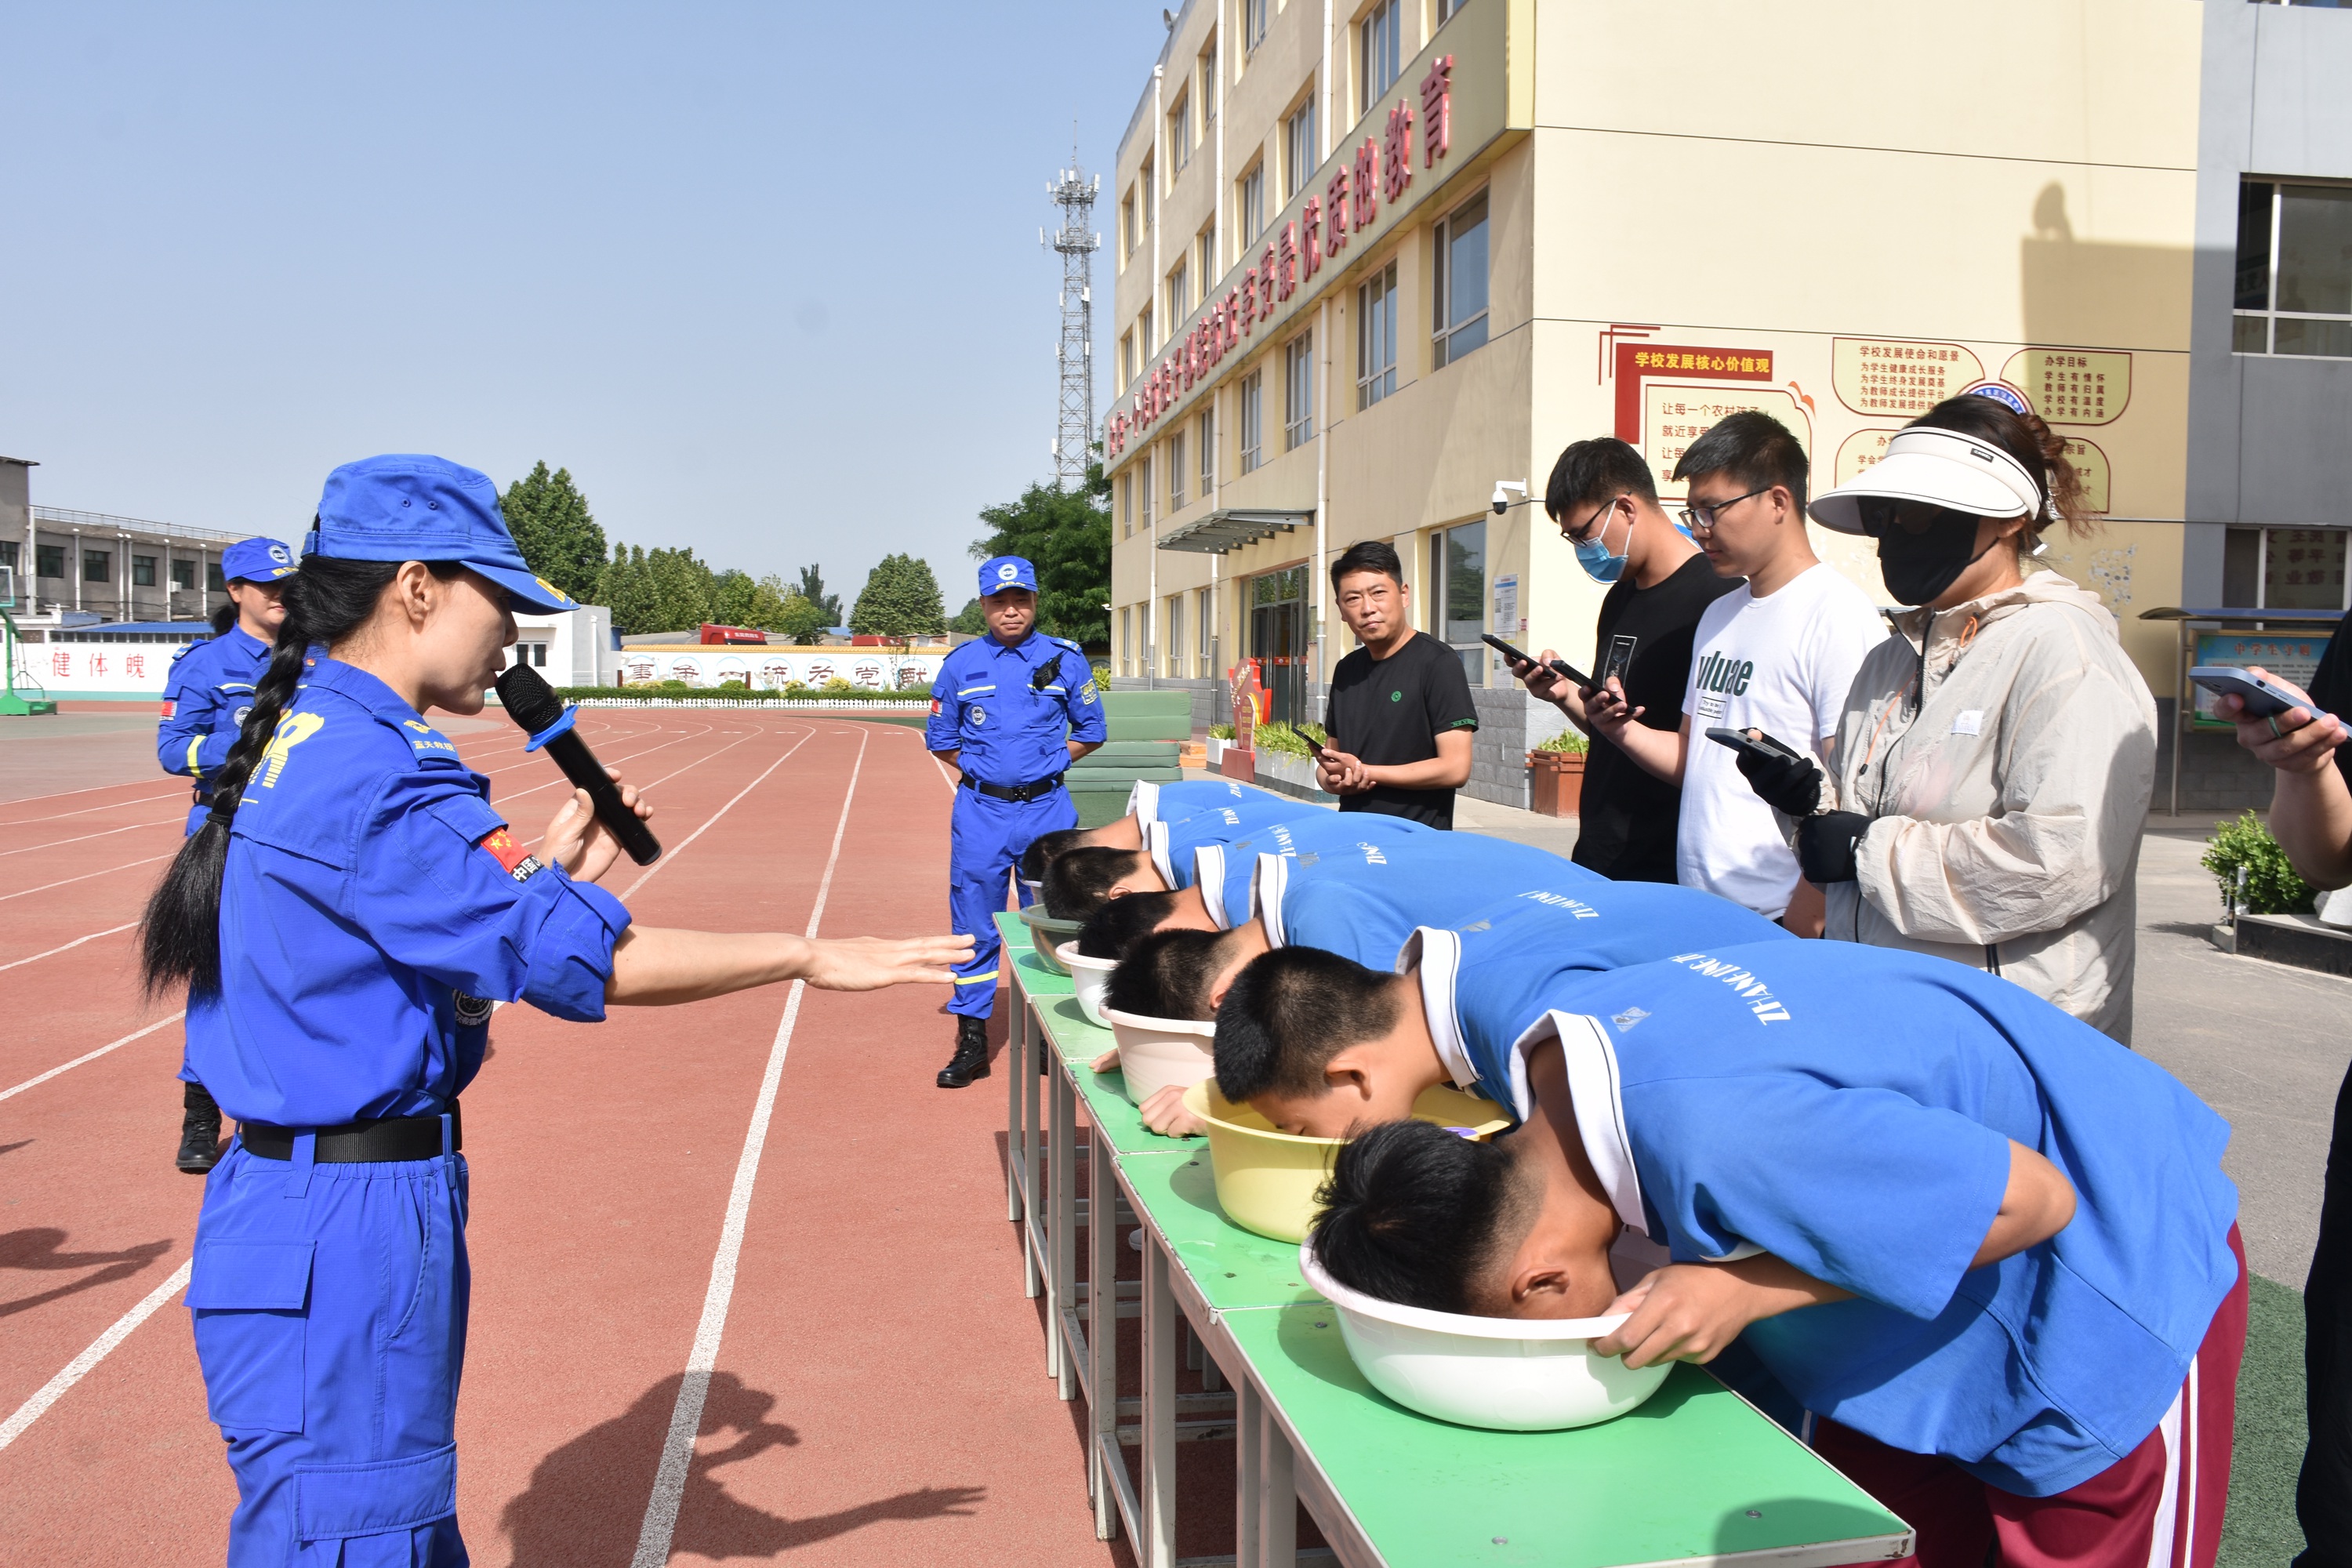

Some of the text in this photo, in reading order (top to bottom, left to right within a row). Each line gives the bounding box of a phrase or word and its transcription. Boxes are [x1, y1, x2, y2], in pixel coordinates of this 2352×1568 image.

[1860, 346, 1959, 362] 学校发展使命和愿景
[1635, 351, 1770, 373] 学校发展核心价值观
[2045, 355, 2087, 368] 办学目标
[1860, 362, 1946, 376] 为学生健康成长服务
[1860, 374, 1946, 388] 为学生终身发展奠基
[2044, 371, 2105, 383] 学生有情怀
[1860, 386, 1945, 399] 为教师成长提供平台
[2044, 394, 2104, 406] 学校有温度
[2234, 642, 2311, 656] 中学生守则
[412, 740, 456, 752] 蓝天救援
